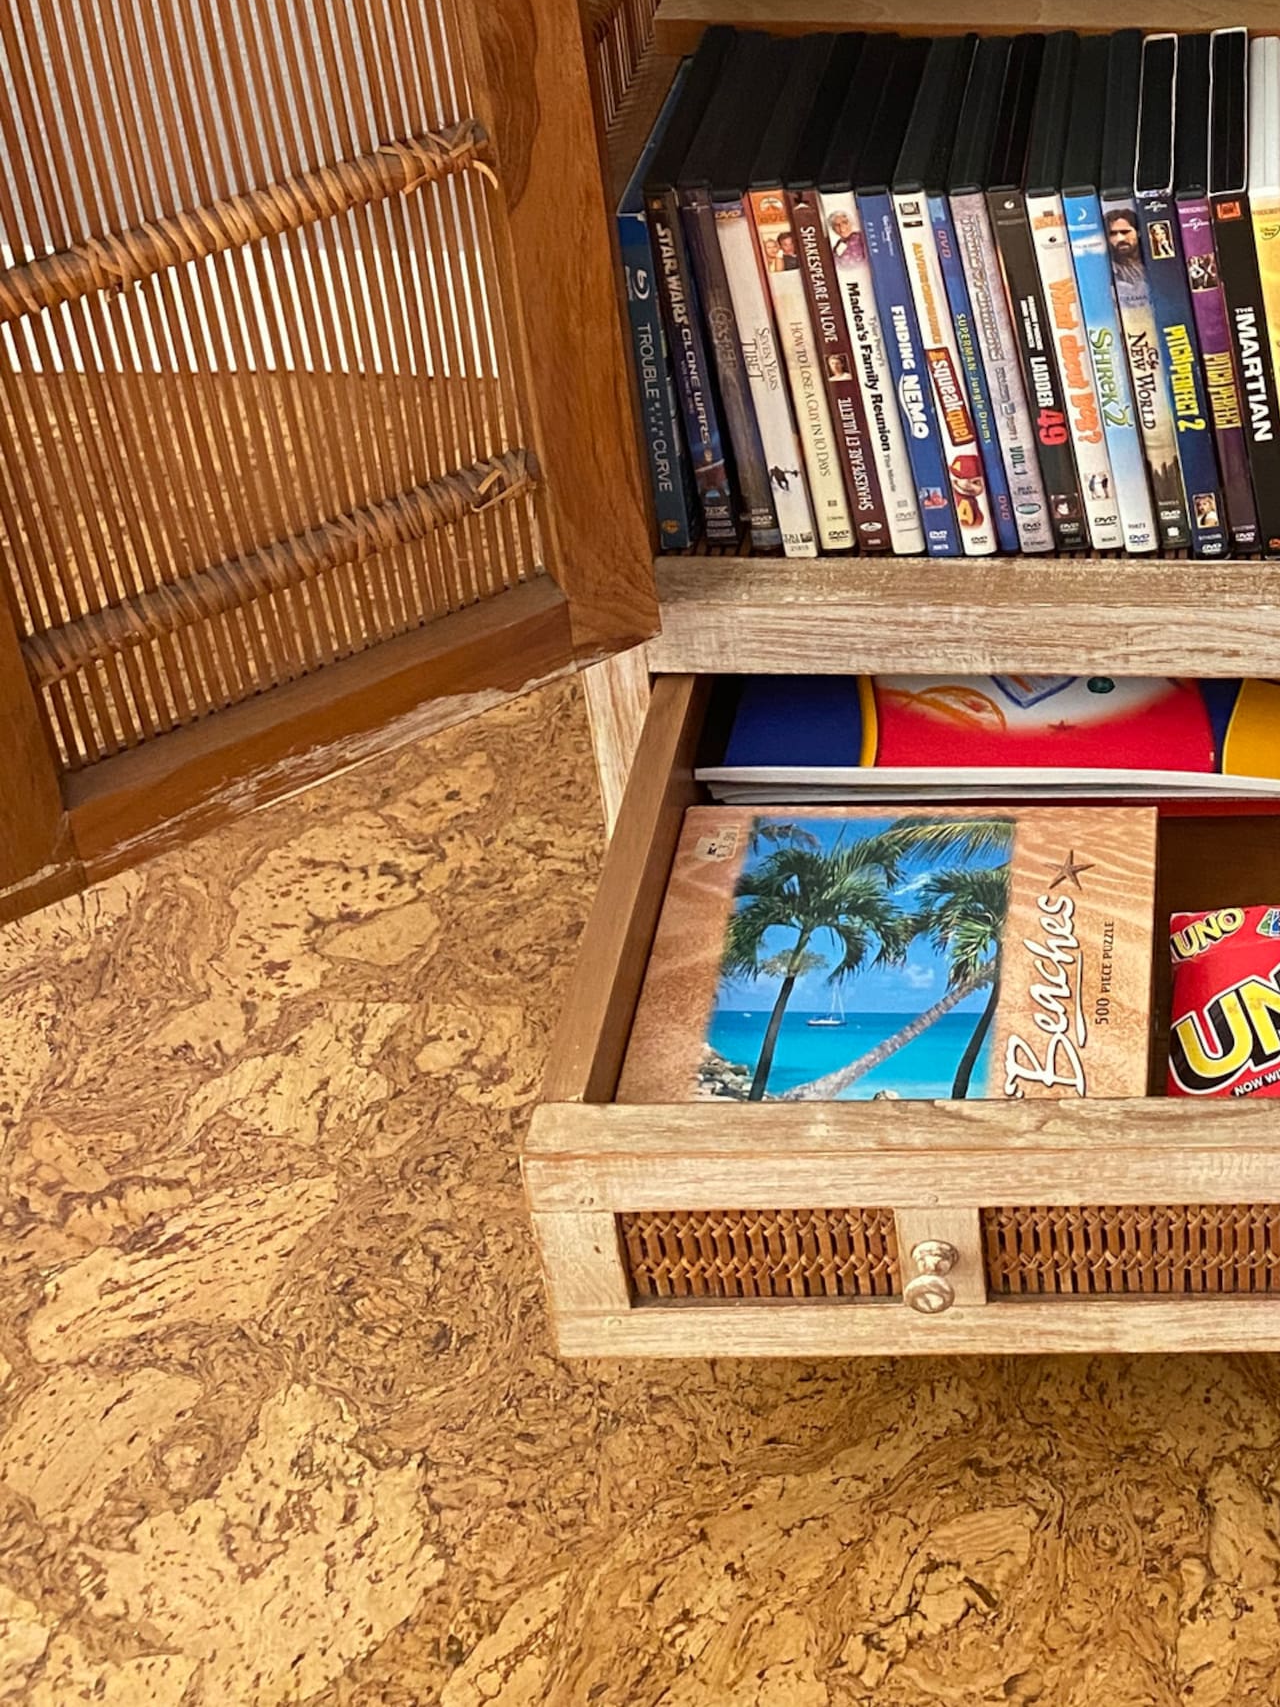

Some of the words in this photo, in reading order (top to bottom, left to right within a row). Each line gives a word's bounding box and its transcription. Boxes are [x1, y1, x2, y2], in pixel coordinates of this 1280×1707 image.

[800, 226, 830, 301] SHAKESPEARE
[937, 229, 952, 259] DVD
[656, 223, 676, 276] STAR
[667, 275, 689, 326] WARS
[817, 300, 832, 315] IN
[846, 282, 868, 343] Madea's
[1049, 278, 1079, 330] What
[1233, 306, 1255, 315] THE
[708, 306, 738, 369] CASPER
[790, 321, 803, 345] HOW
[820, 315, 839, 343] LOVE
[868, 316, 880, 337] Tyler
[890, 305, 917, 370] FINDING
[1163, 324, 1195, 362] PITCH
[741, 338, 765, 383] TIBET
[756, 327, 772, 358] SEVEN
[764, 359, 779, 391] YEARS
[798, 346, 808, 363] TO
[861, 344, 880, 391] Family
[1059, 335, 1090, 390] about
[1128, 331, 1147, 372] NEW
[1202, 351, 1235, 388] PITCH
[681, 328, 701, 387] CLONE
[694, 391, 712, 444] WARS
[801, 363, 813, 389] LOSE
[1029, 356, 1056, 408] LADDER
[1170, 361, 1201, 416] PERFECT
[1235, 313, 1274, 443] MARTIAN
[637, 322, 660, 399] TROUBLE
[653, 438, 673, 492] CURVE
[808, 399, 822, 423] GUY
[837, 397, 861, 437] JULIETTE
[900, 374, 930, 439] NEMO
[932, 360, 974, 444] squeakquel
[969, 376, 984, 410] Jungle
[978, 411, 992, 445] Drums
[1103, 404, 1135, 428] 2
[1135, 372, 1157, 430] WORLD
[1207, 386, 1243, 430] PERFECT
[812, 423, 824, 436] IN
[845, 436, 861, 447] ET
[870, 393, 892, 453] Reunion
[1036, 408, 1069, 446] 49
[1177, 418, 1207, 432] 2
[814, 437, 826, 451] 10
[816, 451, 832, 477] DAYS
[884, 454, 893, 468] The
[1009, 445, 1027, 470] VOL.
[849, 447, 875, 512] SHAKESPEARE
[998, 495, 1011, 521] DVD
[1103, 920, 1115, 960] PUZZLE
[1171, 907, 1246, 959] UNO
[1004, 894, 1087, 1098] Beaches
[1100, 961, 1113, 993] PIECE
[1095, 996, 1110, 1025] 500
[1232, 1077, 1264, 1096] NOW
